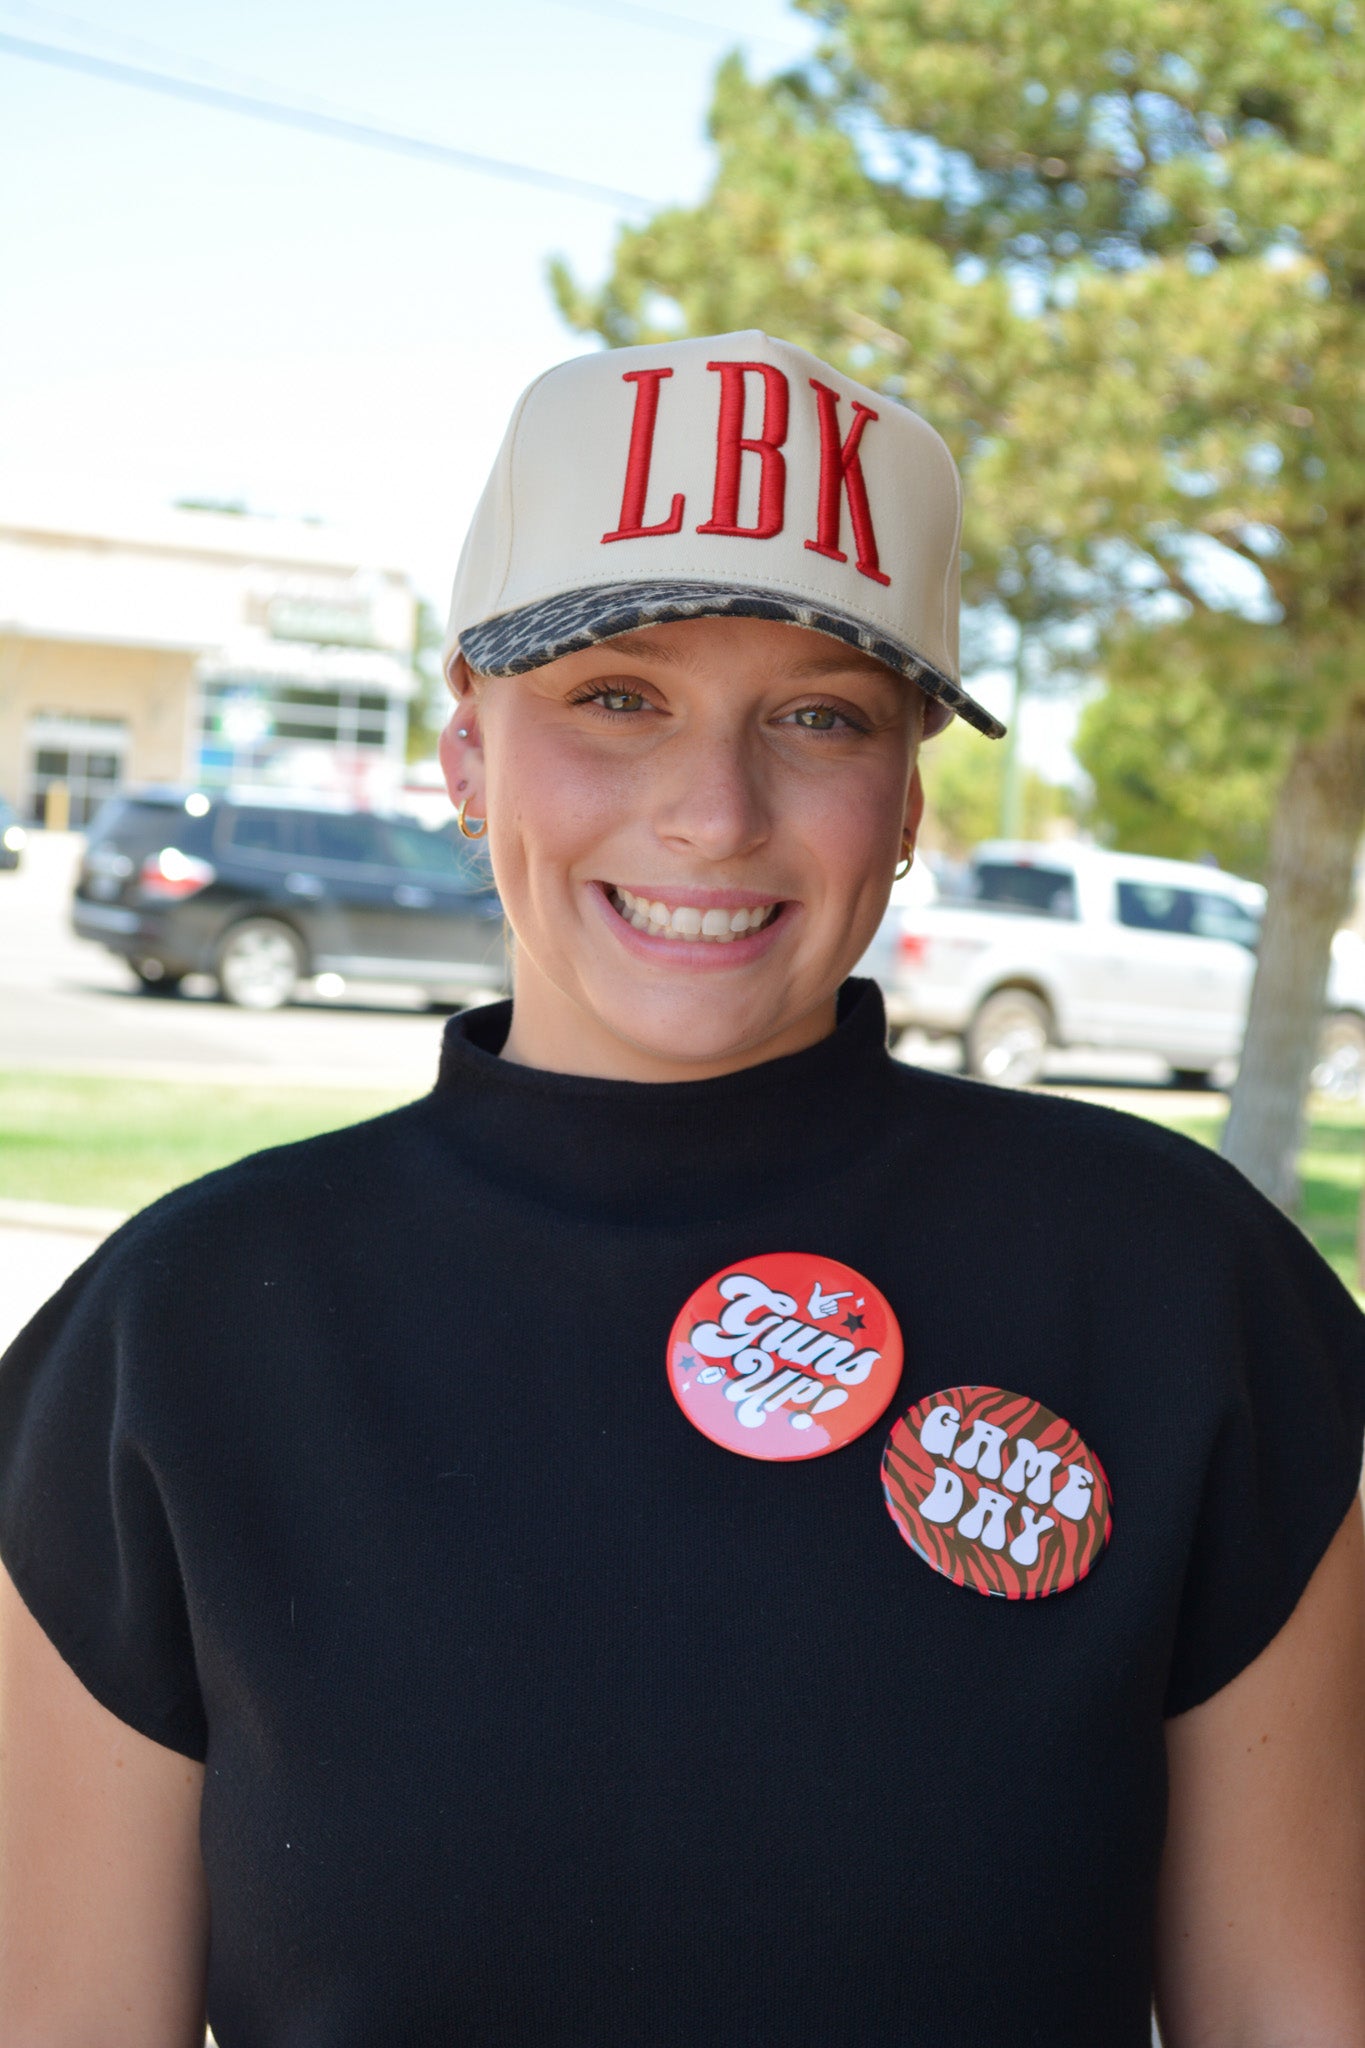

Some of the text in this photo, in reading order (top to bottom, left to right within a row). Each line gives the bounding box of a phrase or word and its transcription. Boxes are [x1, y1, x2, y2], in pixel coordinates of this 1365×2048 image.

[600, 361, 891, 587] LBK
[690, 1272, 881, 1385] Guns
[723, 1347, 848, 1431] Up!
[918, 1467, 1055, 1566] DAY
[919, 1405, 1094, 1520] GAME
